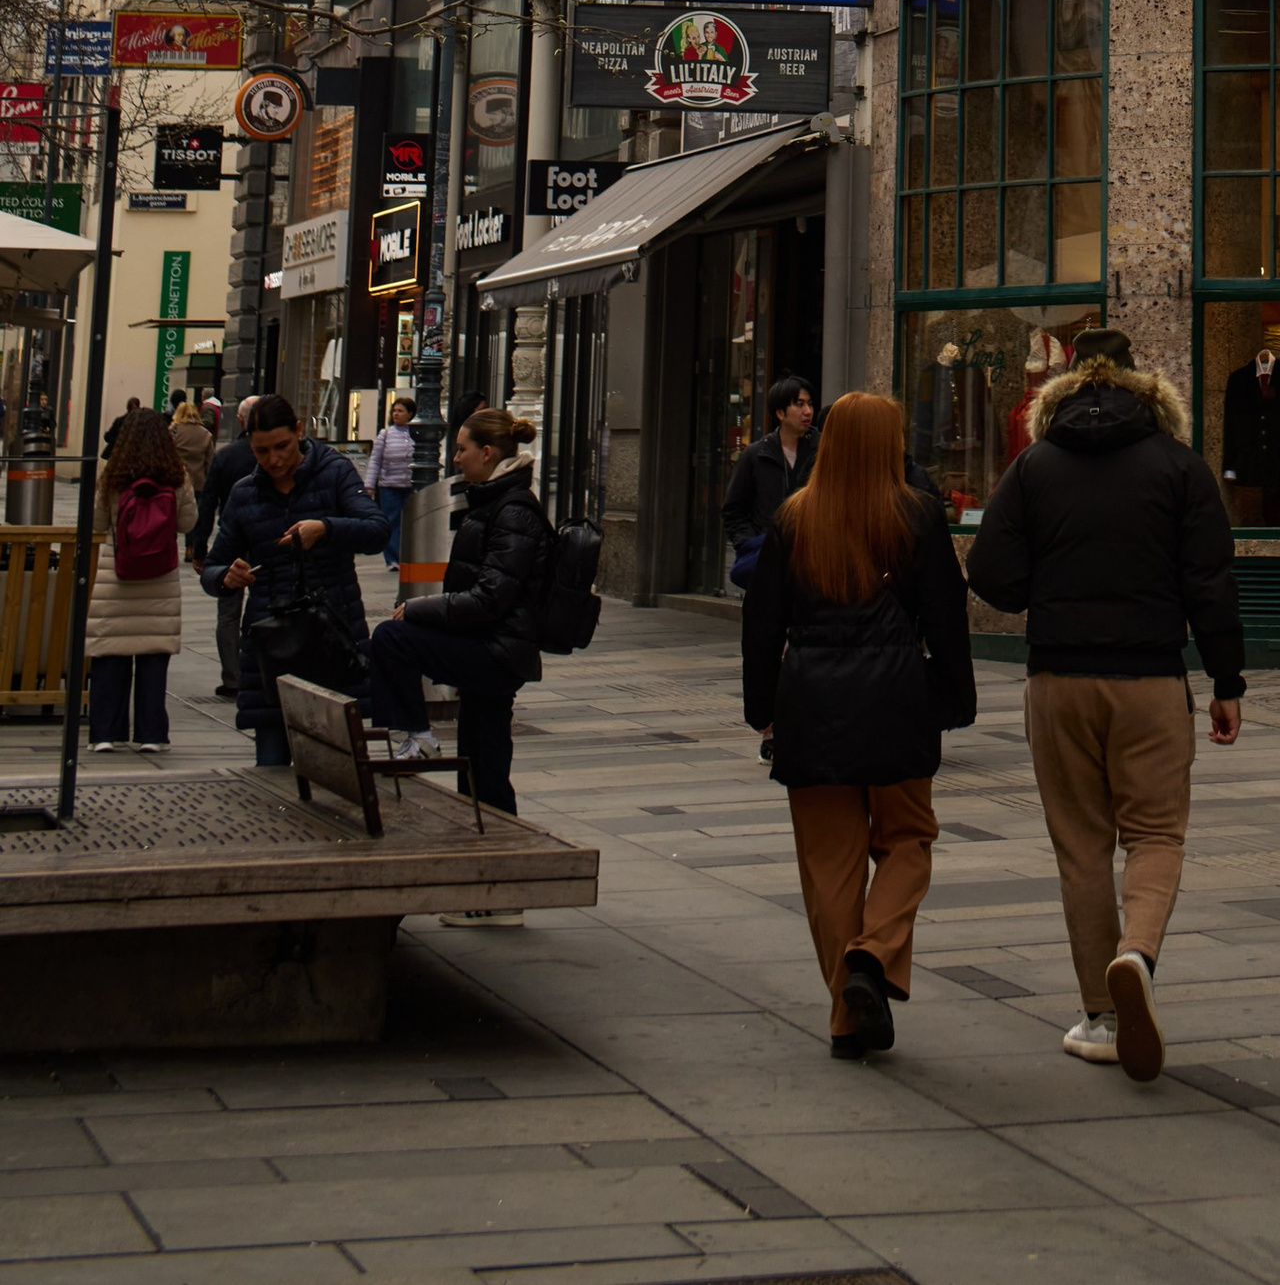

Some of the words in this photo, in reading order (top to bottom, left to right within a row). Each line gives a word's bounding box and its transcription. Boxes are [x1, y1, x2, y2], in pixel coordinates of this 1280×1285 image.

[581, 41, 646, 57] NEAPOLITAN
[767, 48, 818, 62] AUSTRIAN
[598, 57, 628, 71] PIZZA
[779, 63, 805, 76] BEER
[663, 87, 682, 97] meets
[685, 84, 720, 96] Austrian
[723, 87, 740, 99] Beer
[730, 112, 770, 134] RESTAURANT
[161, 149, 217, 161] TISSOT
[386, 172, 427, 182] MOBILE
[547, 166, 598, 189] Foot
[455, 214, 473, 251] Foot
[473, 205, 504, 247] Locker
[380, 228, 411, 263] MOBILE
